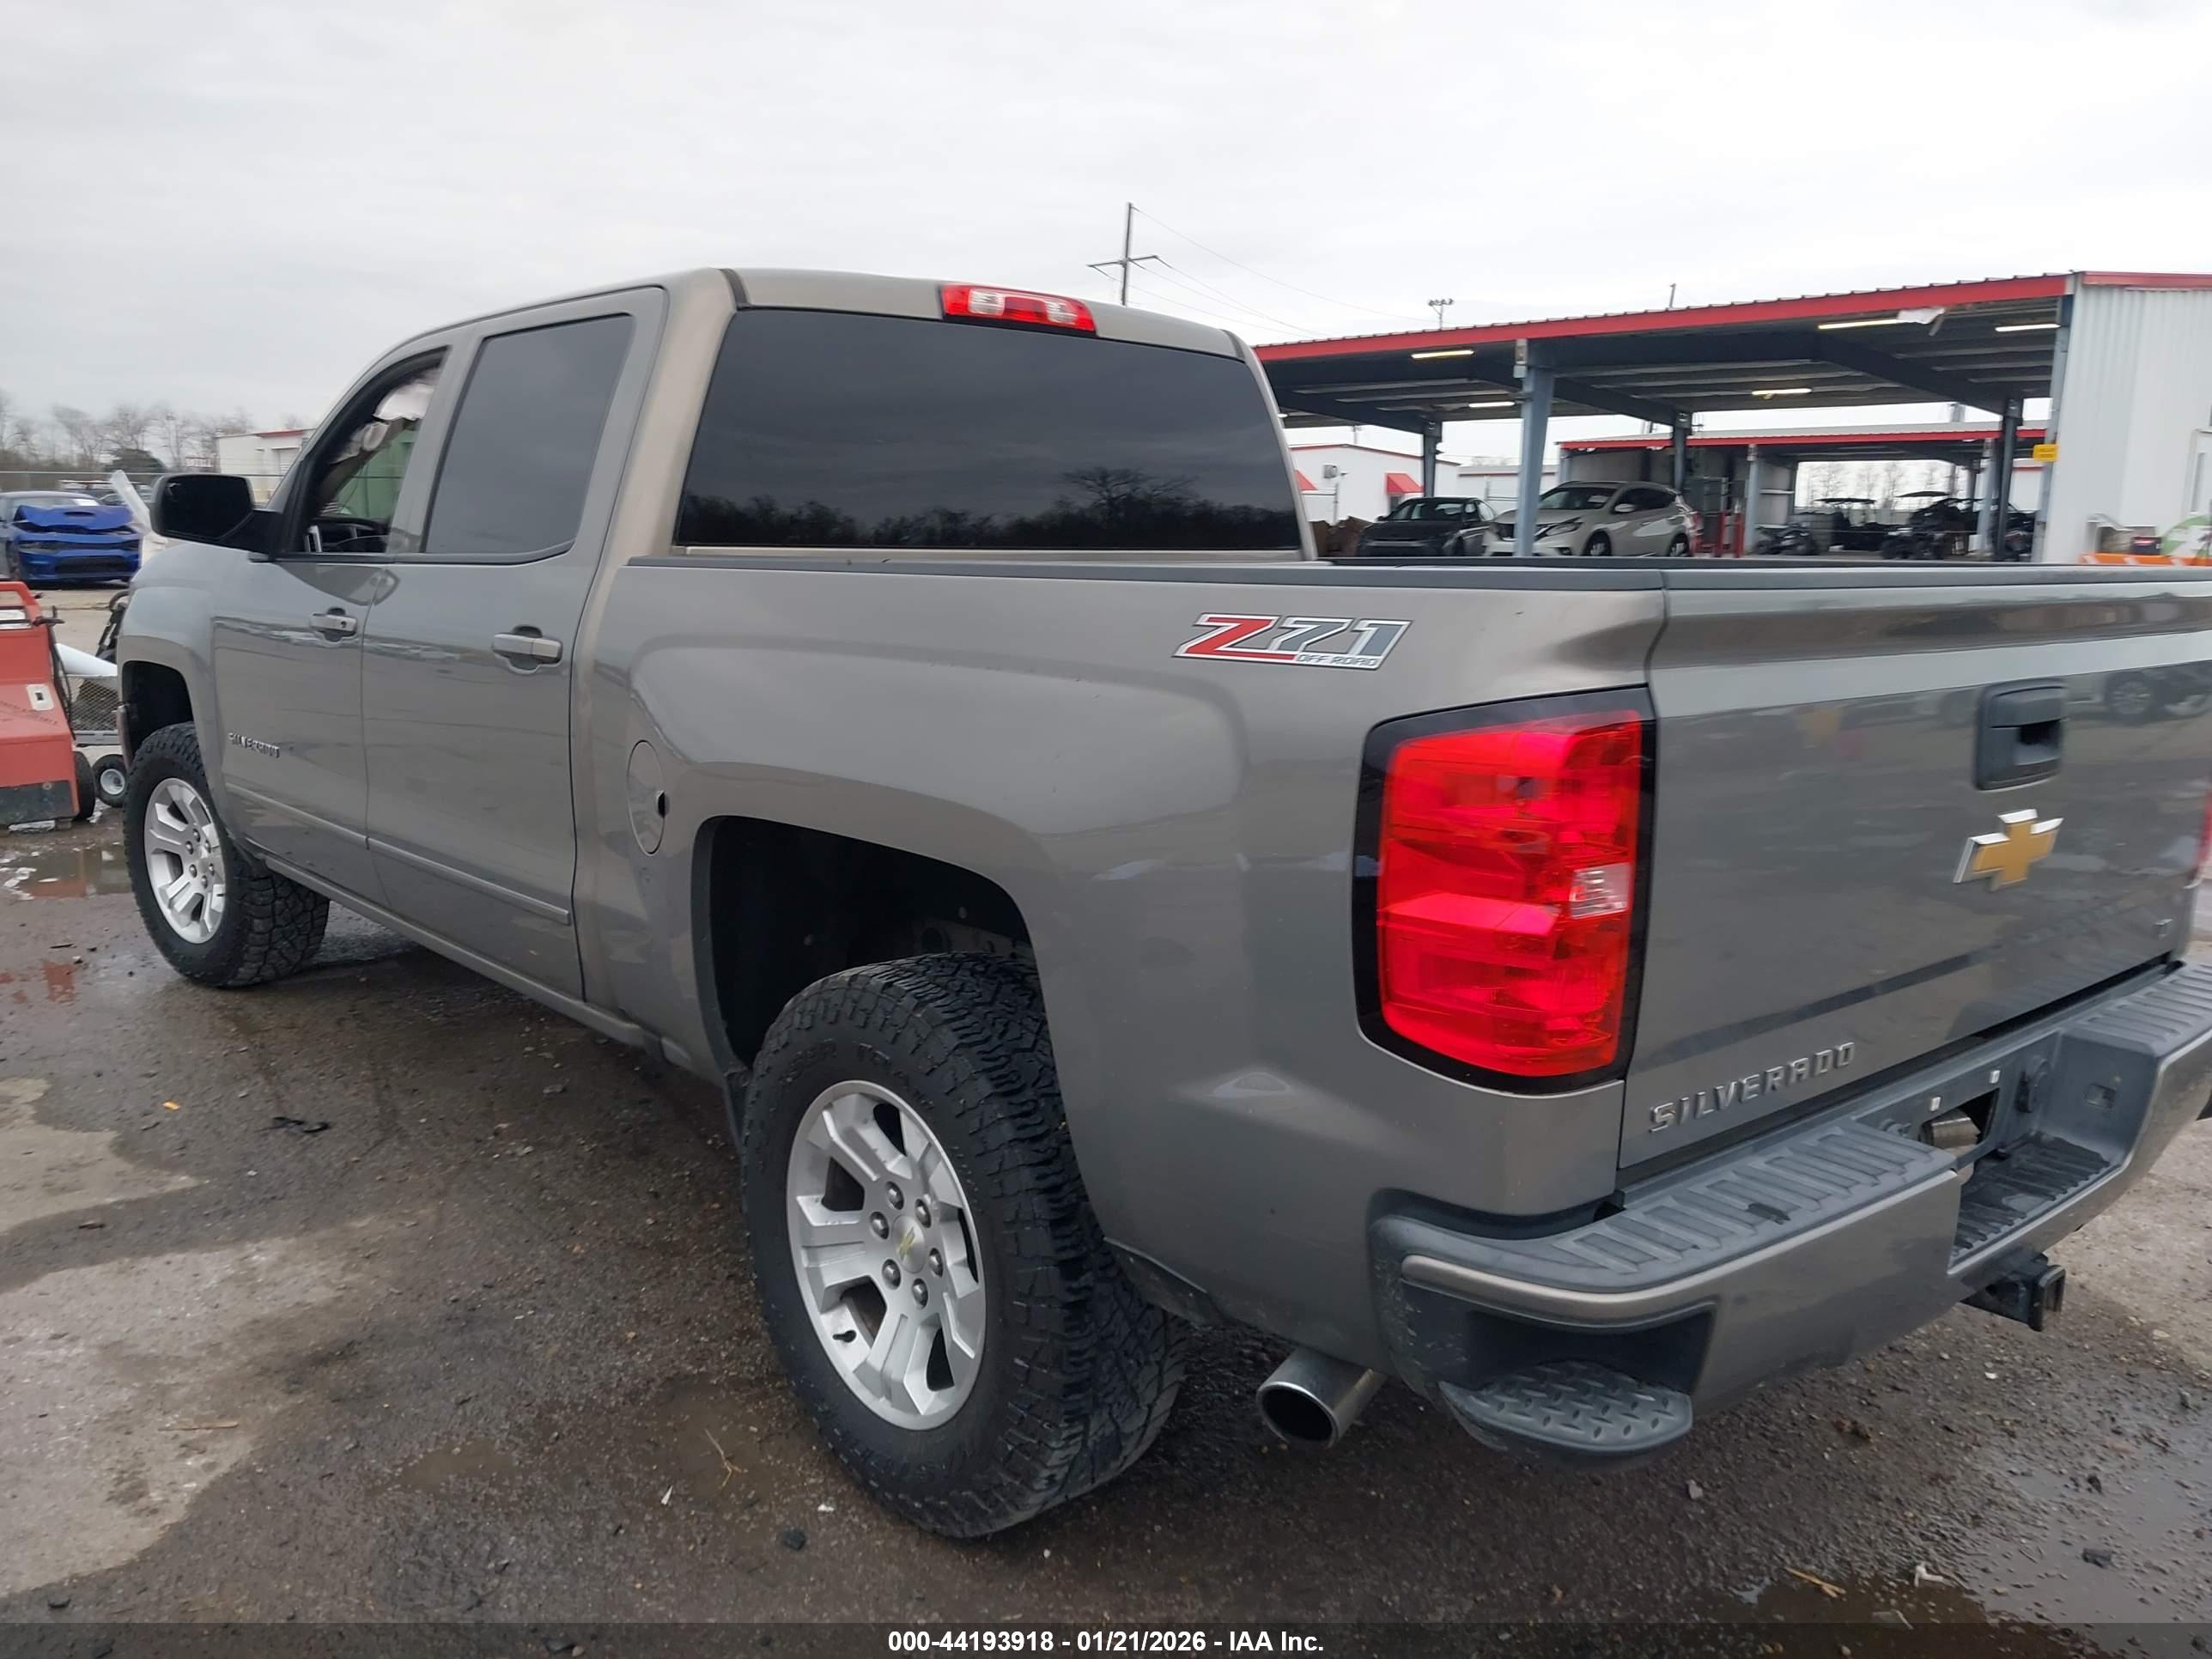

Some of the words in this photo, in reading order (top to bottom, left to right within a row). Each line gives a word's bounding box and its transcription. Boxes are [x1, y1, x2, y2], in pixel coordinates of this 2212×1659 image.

[1173, 612, 1414, 665] Z71
[1297, 653, 1329, 663] OFF
[1330, 656, 1379, 666] ROAD
[1648, 1041, 1856, 1133] SILVERADO
